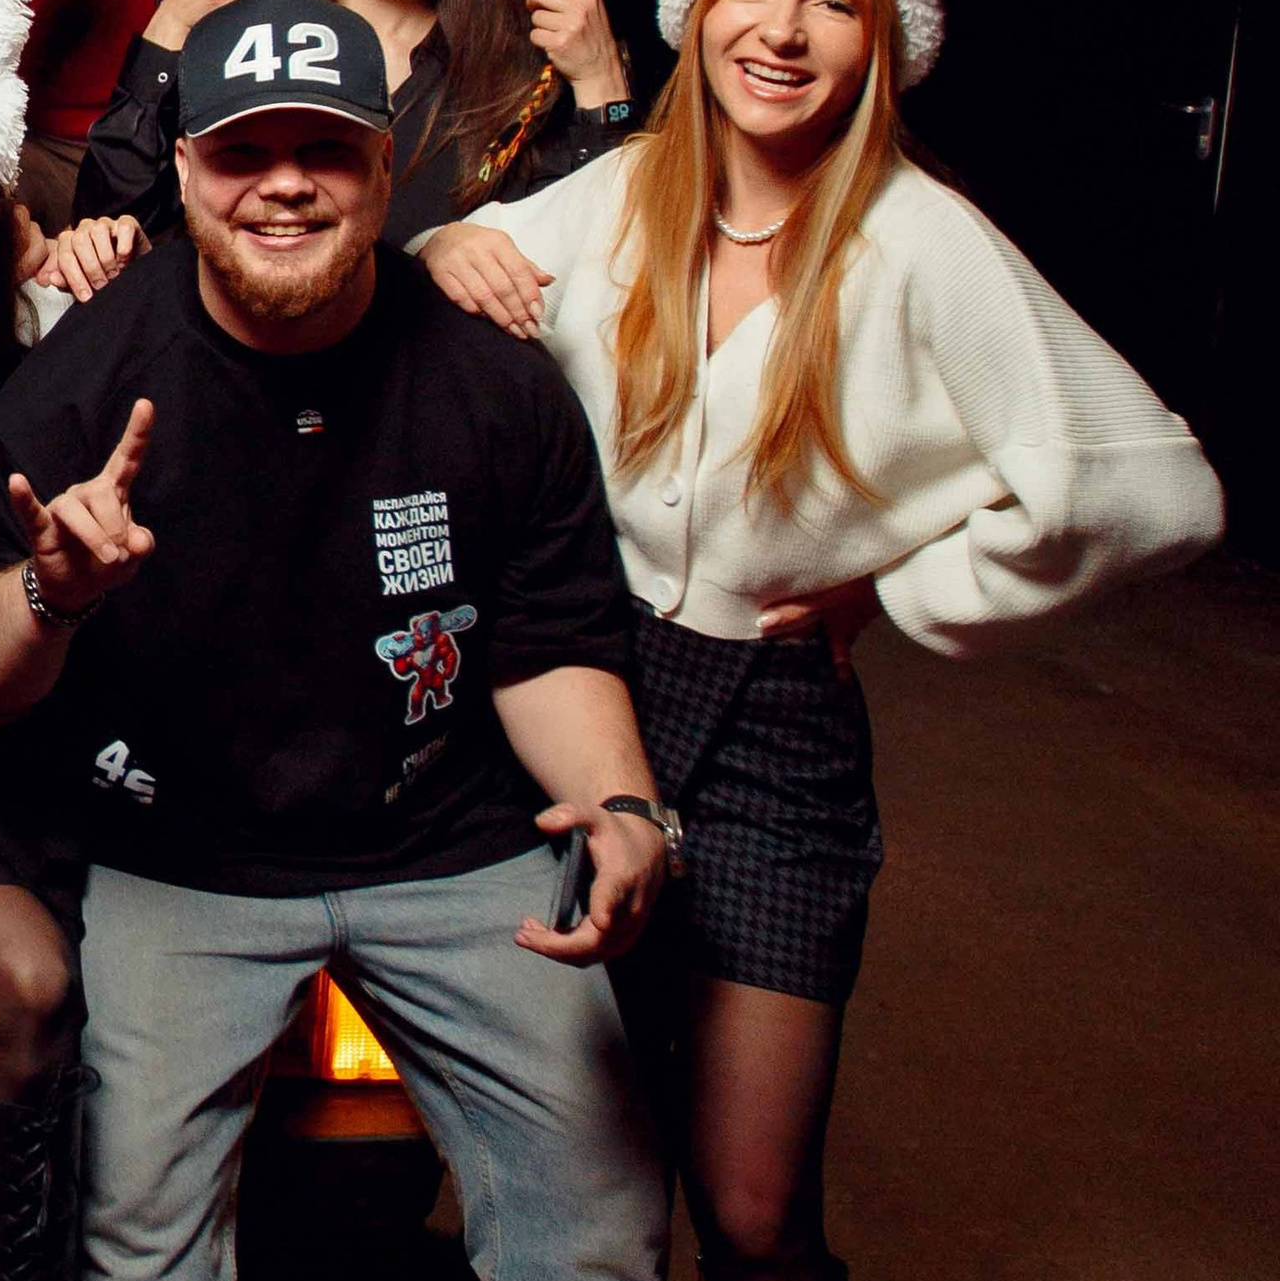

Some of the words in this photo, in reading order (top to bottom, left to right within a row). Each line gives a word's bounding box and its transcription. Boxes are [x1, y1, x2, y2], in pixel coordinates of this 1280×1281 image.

[224, 22, 342, 85] 42
[373, 490, 447, 511] НАСЛАЖДАЙСЯ
[373, 505, 448, 530] КАЖДЫМ
[375, 524, 451, 548] МОМЕНТОМ
[377, 537, 452, 574] СВОЕЙ
[380, 562, 455, 596] ЖИЗНИ
